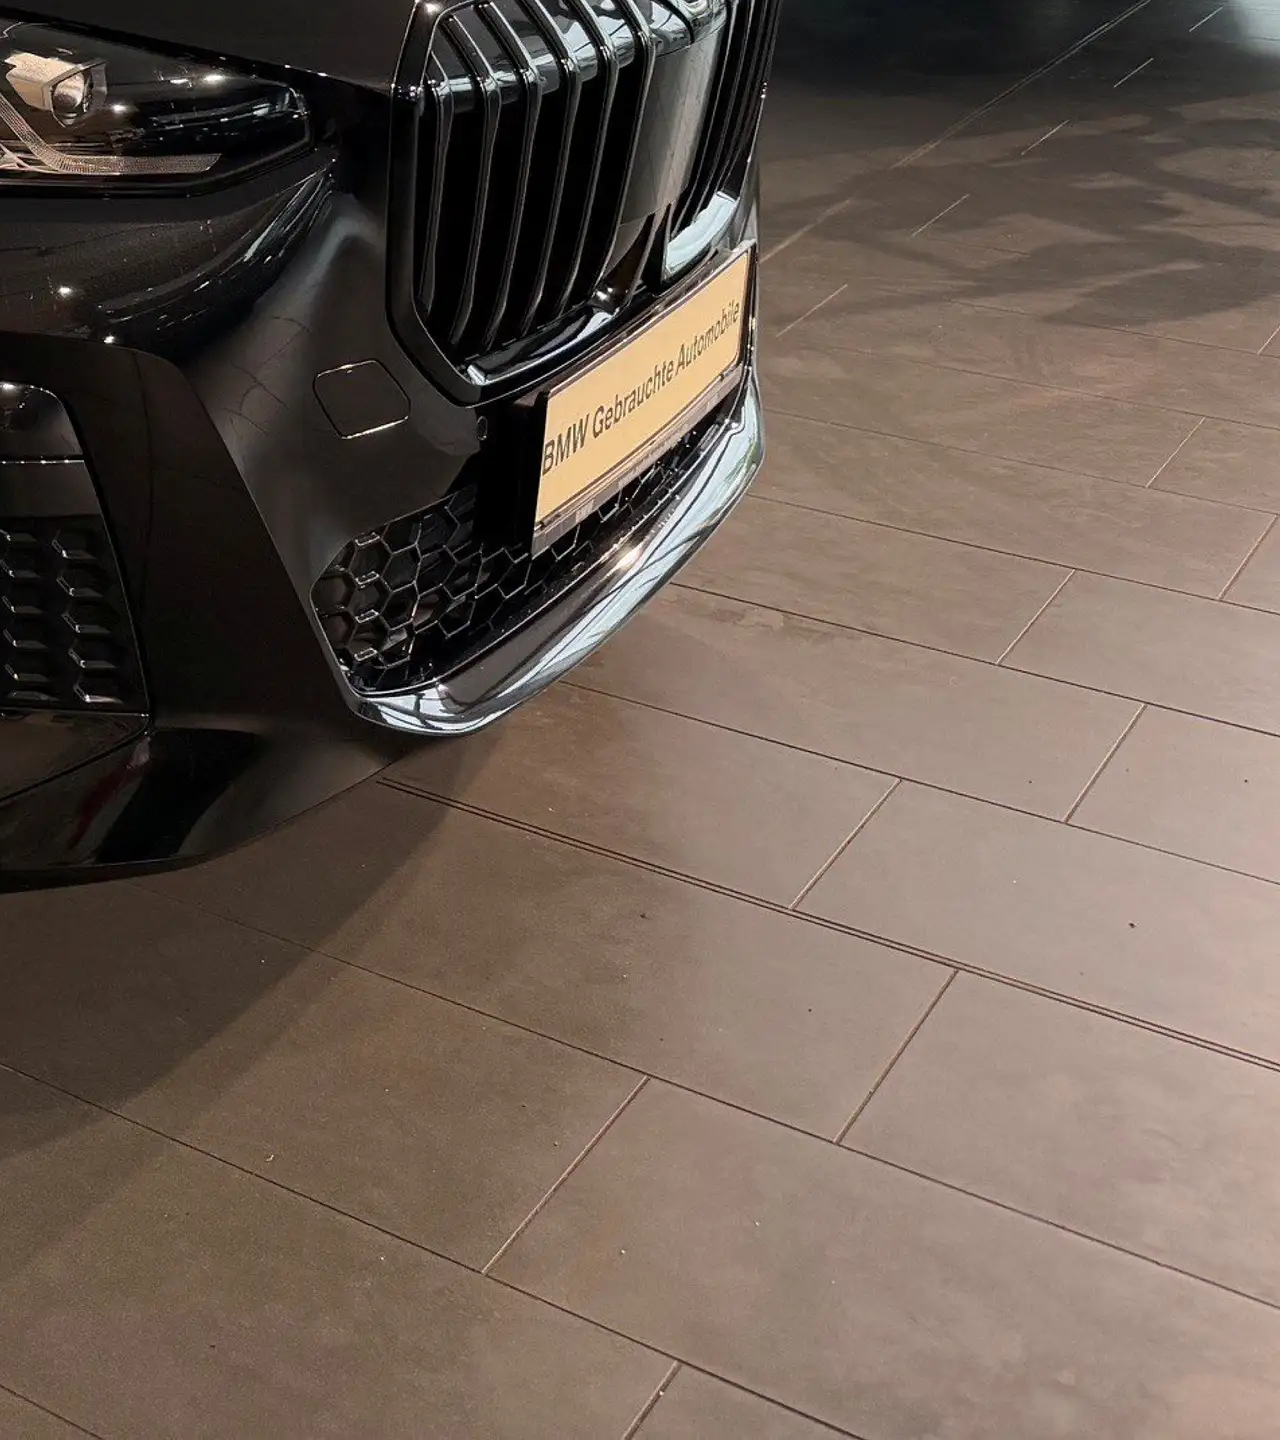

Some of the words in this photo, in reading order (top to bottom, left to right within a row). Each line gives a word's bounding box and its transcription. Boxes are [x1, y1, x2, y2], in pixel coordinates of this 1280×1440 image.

[542, 413, 590, 475] BMW
[592, 361, 674, 438] Gebrauchte
[675, 300, 740, 376] Automobile
